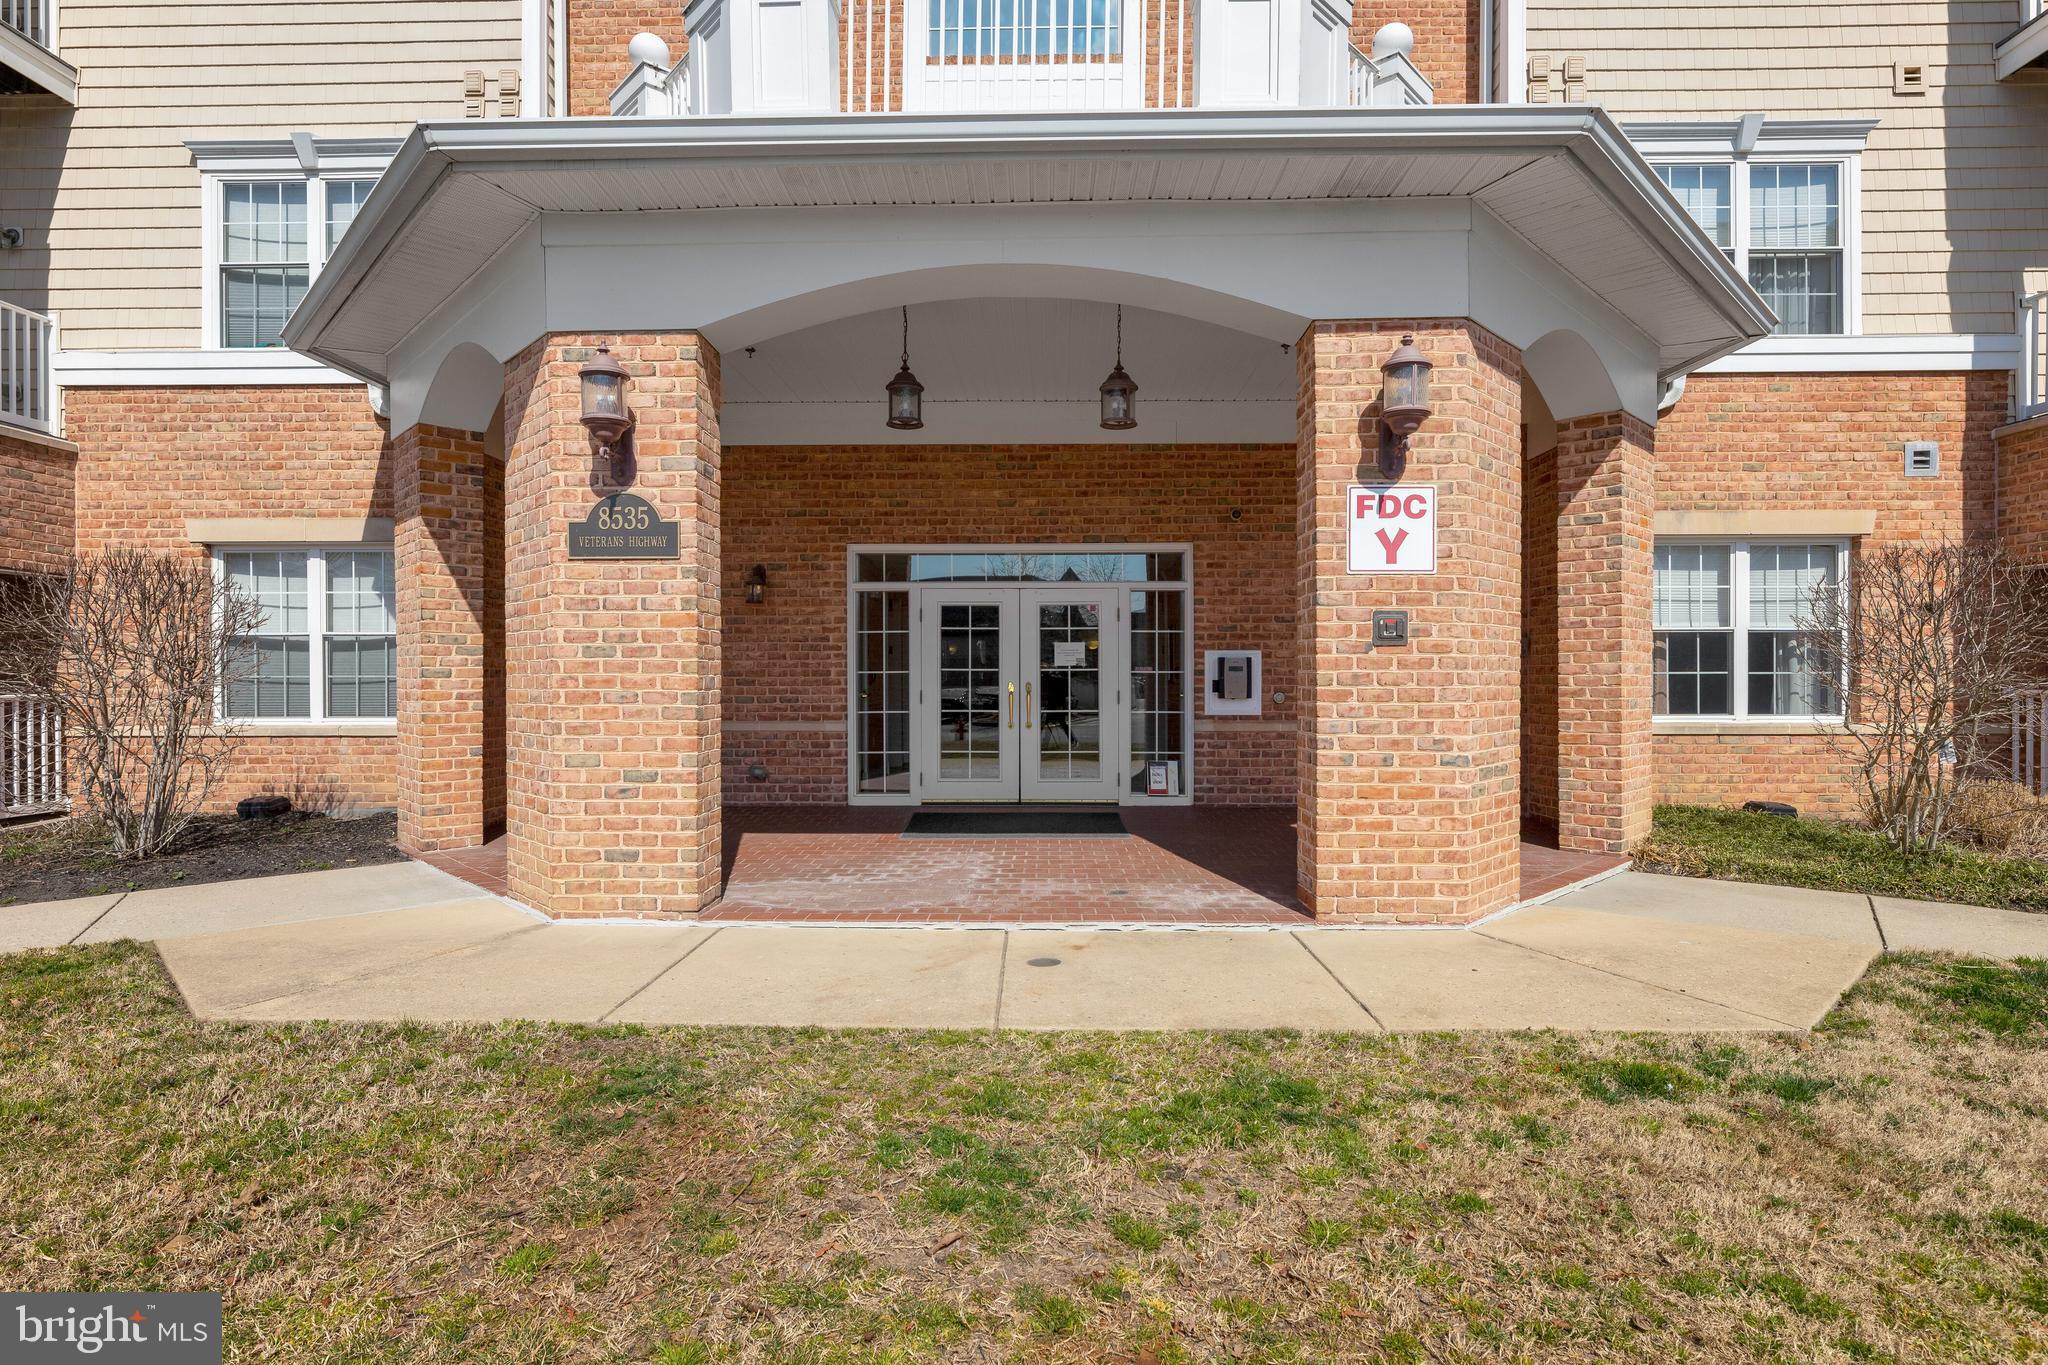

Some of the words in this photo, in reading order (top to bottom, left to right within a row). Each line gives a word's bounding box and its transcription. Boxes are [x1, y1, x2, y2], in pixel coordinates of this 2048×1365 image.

[598, 506, 649, 530] 8535
[1356, 494, 1427, 519] FDC
[578, 535, 624, 548] VETERANS
[628, 535, 668, 548] HIGHWAY
[1374, 527, 1410, 565] Y
